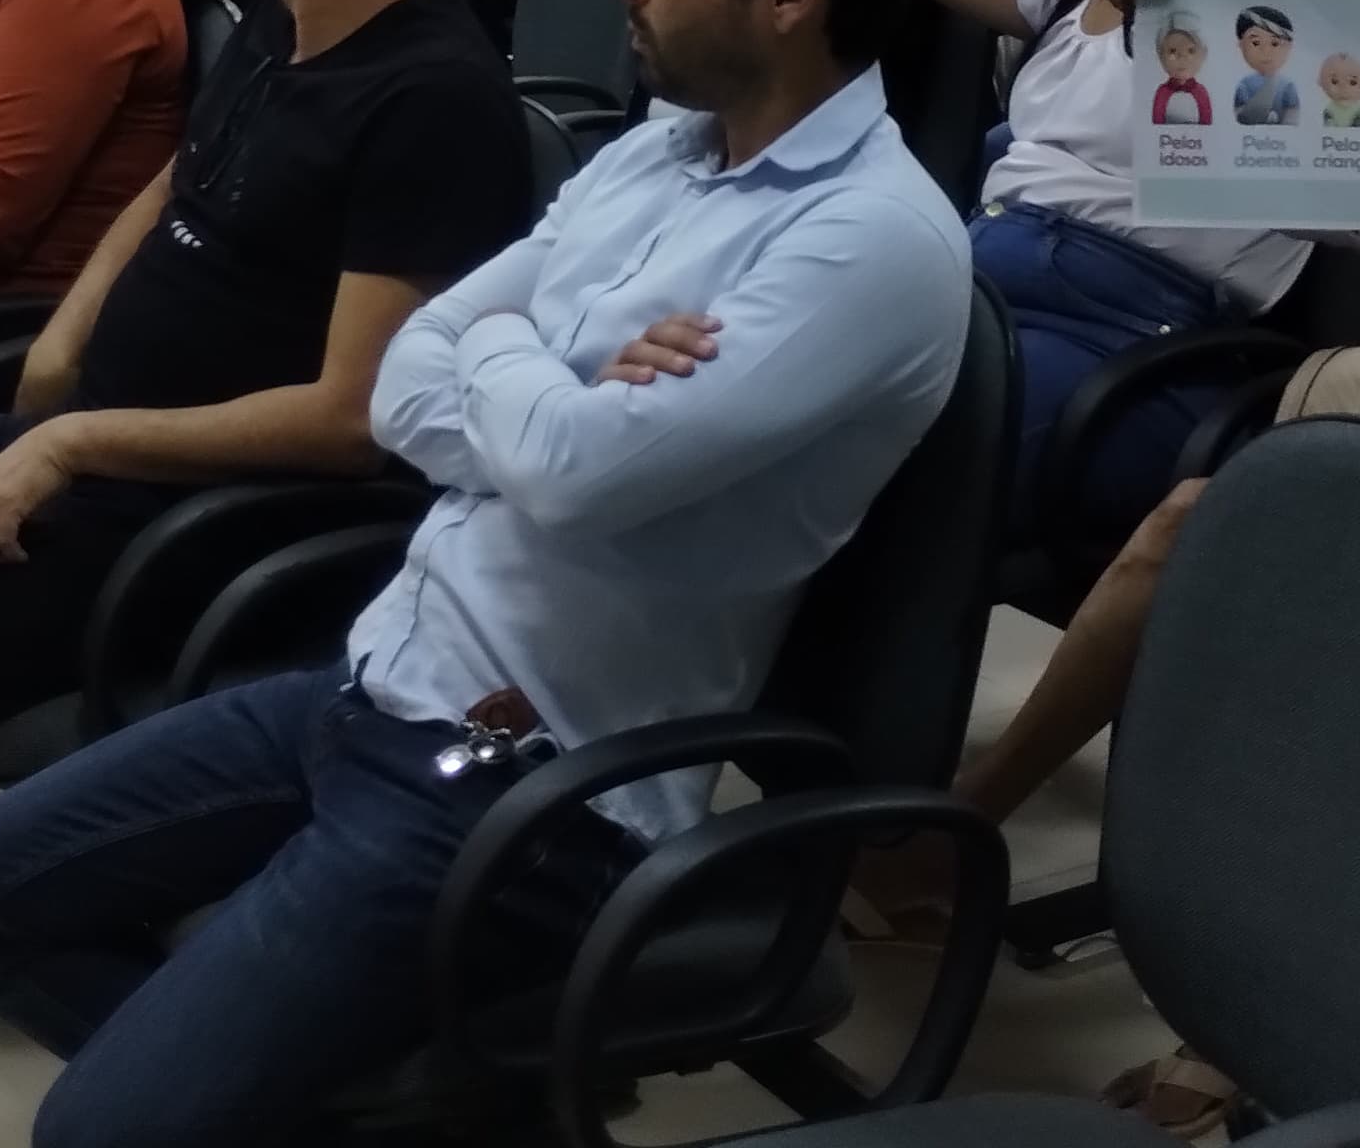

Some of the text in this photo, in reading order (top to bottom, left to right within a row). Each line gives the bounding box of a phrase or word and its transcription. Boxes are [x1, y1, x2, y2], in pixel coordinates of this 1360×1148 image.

[1159, 134, 1203, 151] Pelos
[1242, 135, 1288, 151] Pelos
[1159, 152, 1209, 168] idosos
[1233, 153, 1301, 169] doentes
